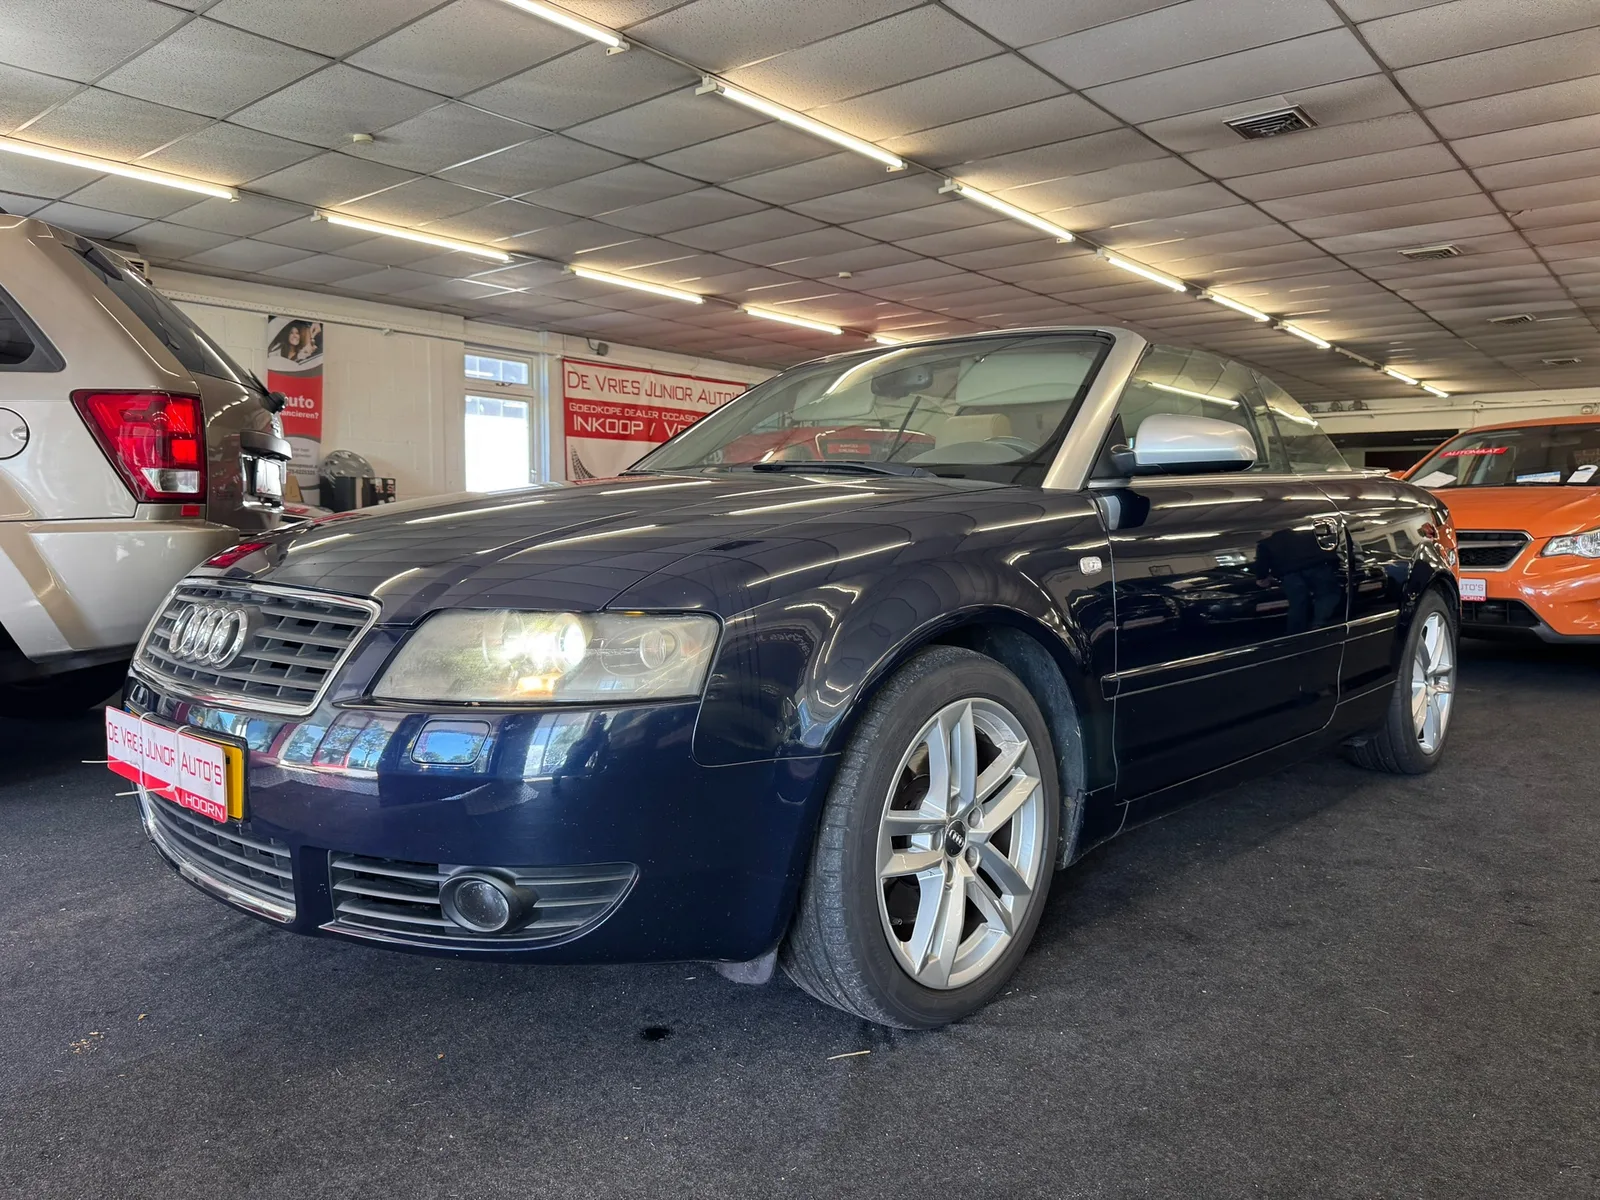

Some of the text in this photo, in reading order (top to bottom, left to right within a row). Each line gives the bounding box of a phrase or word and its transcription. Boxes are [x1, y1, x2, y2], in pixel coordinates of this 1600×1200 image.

[568, 371, 591, 391] DE
[594, 374, 640, 396] VRIES
[645, 380, 693, 402] JUNIOR
[569, 402, 622, 416] GOEDKOPE
[624, 408, 659, 419] DEALER
[573, 414, 644, 435] INKOOP
[649, 422, 656, 436] /
[1444, 448, 1500, 457] AUTOMAAT
[108, 721, 119, 745] DE
[145, 738, 176, 768] JUNIOR
[181, 752, 222, 786] AUTO'S
[185, 792, 224, 820] HOORN
